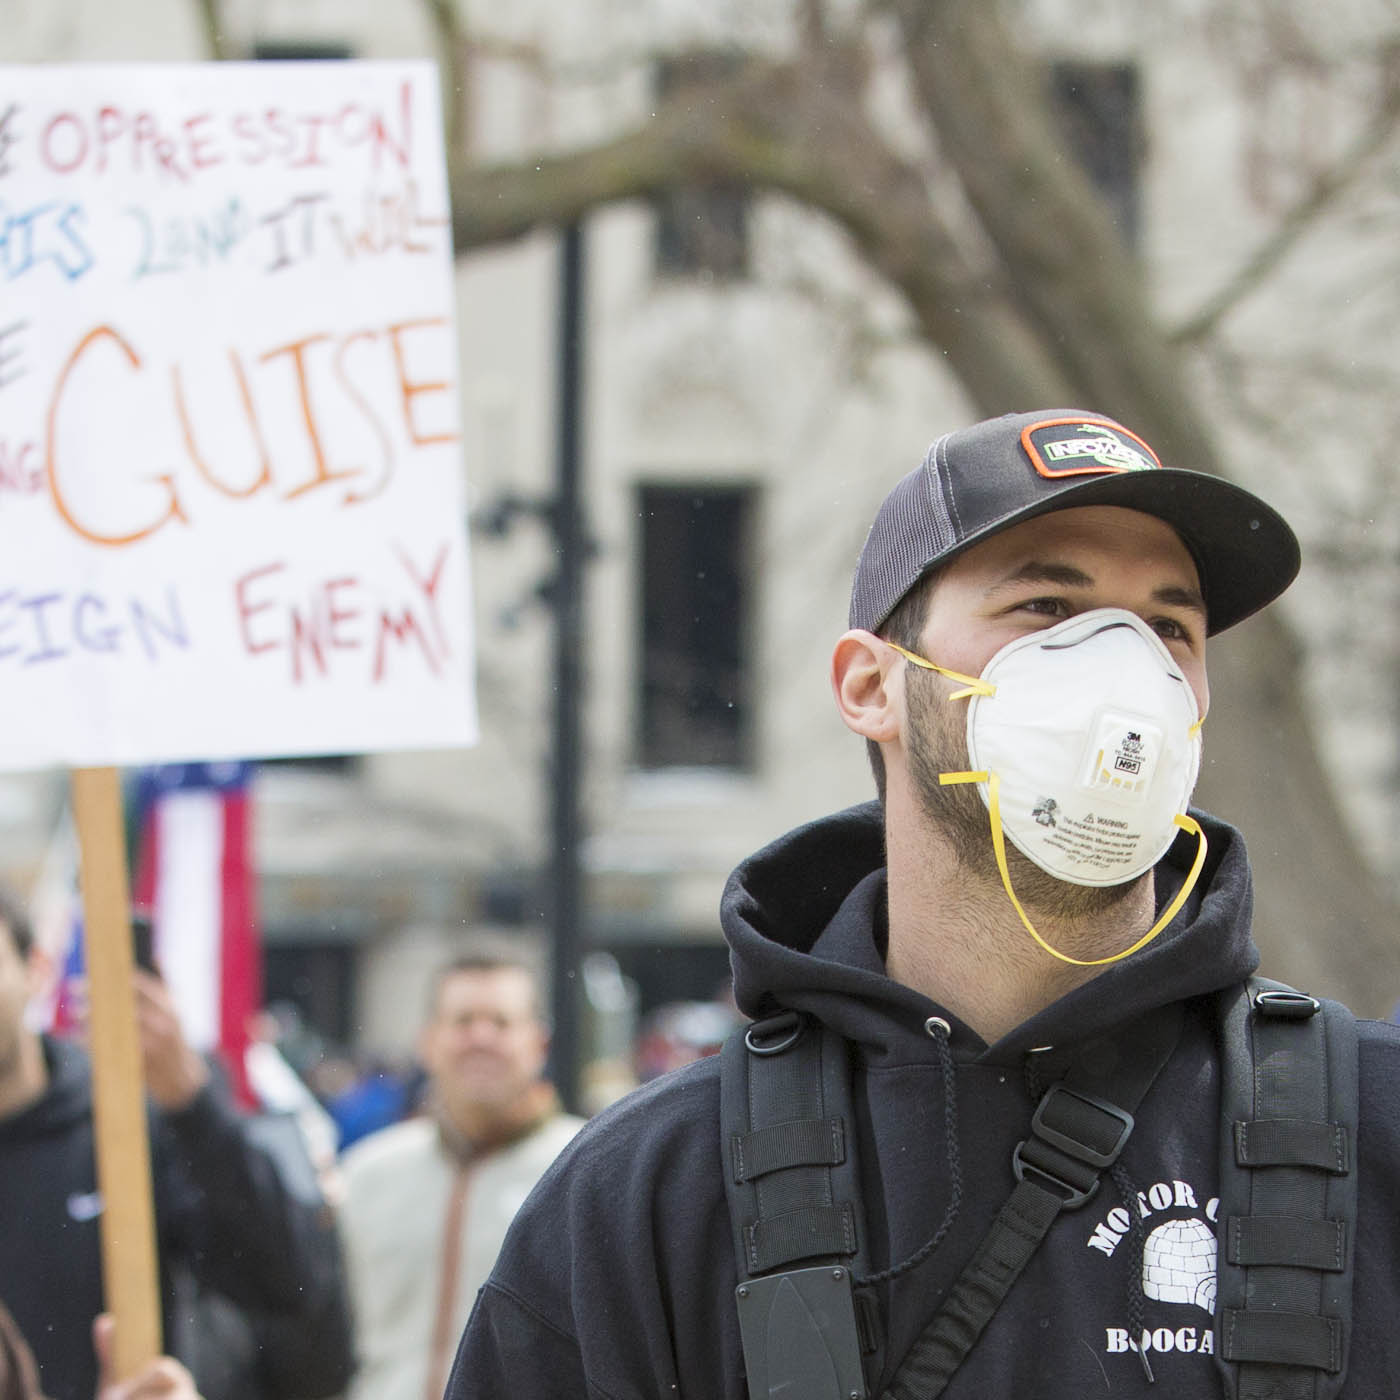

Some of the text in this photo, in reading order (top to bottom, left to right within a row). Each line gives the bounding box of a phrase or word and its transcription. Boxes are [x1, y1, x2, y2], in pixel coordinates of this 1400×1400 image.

[44, 316, 464, 550] GUISE
[234, 540, 458, 687] ENEMY
[1119, 759, 1137, 771] N95
[1127, 731, 1141, 742] 3M
[1087, 1180, 1198, 1258] MOTOR
